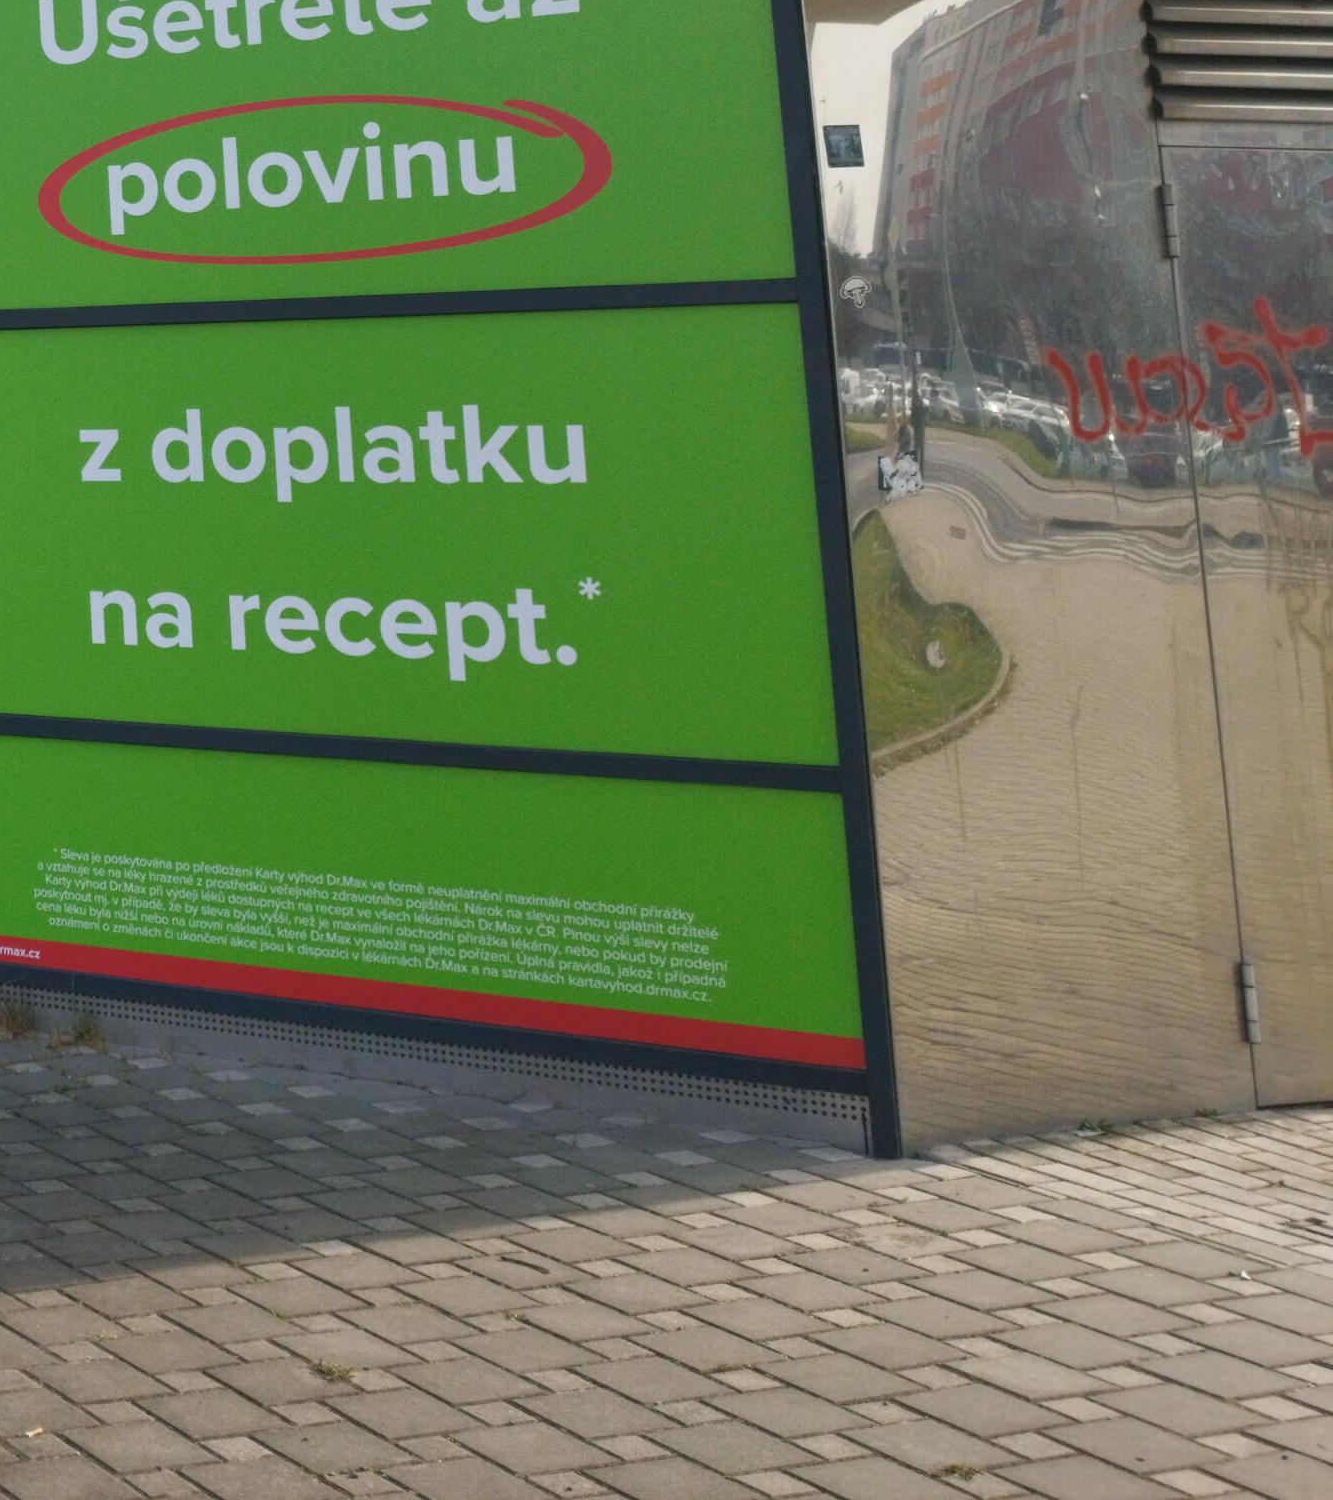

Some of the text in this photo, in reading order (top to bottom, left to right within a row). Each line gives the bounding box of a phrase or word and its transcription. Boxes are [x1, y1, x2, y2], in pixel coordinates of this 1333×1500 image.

[107, 121, 517, 236] polovinu
[78, 403, 589, 503] z doplatku
[88, 588, 193, 649] na
